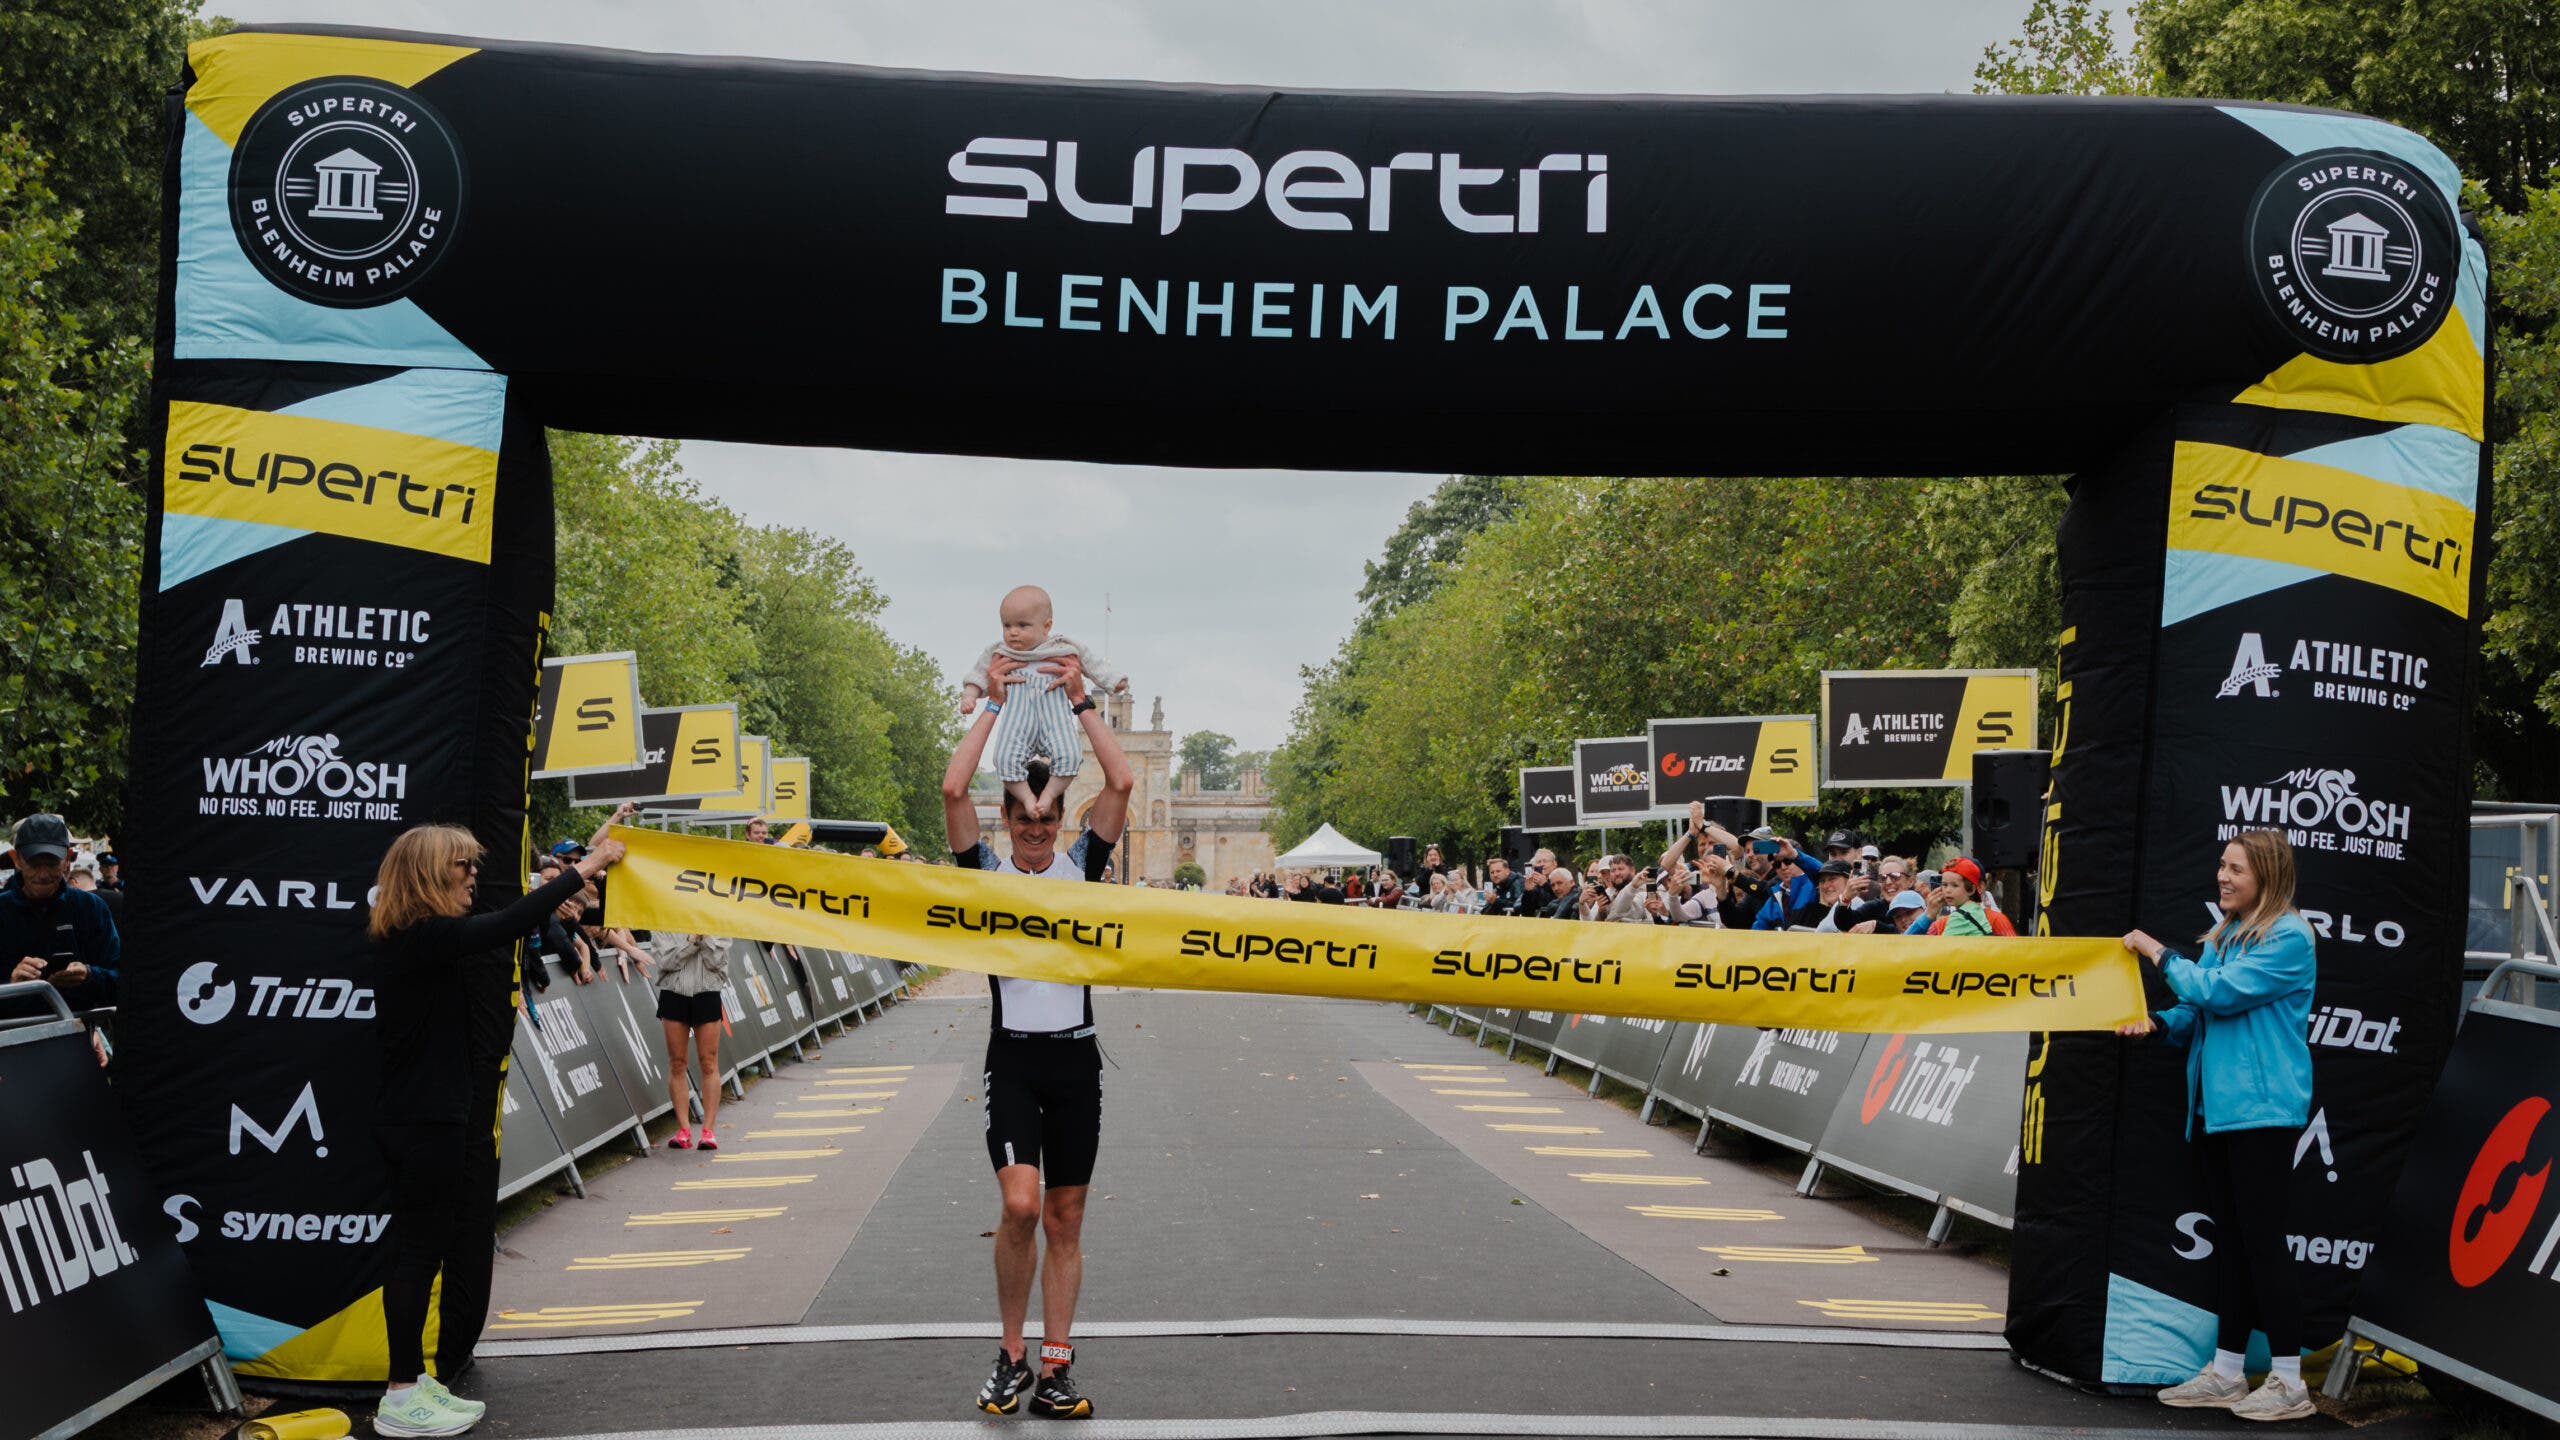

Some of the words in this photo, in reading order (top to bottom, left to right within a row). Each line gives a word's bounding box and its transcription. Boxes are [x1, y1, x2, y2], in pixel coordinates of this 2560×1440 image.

[287, 97, 417, 134] SUPERTRI
[2298, 166, 2417, 201] SUPERTRI
[251, 198, 354, 287] BLENHEIM
[366, 207, 442, 285] PALACE
[941, 269, 1398, 340] BLENHEIM
[1445, 284, 1792, 340] PALACE
[2268, 254, 2359, 344] BLENHEIM
[2370, 271, 2440, 343] PALACE
[270, 603, 431, 644] ATHLETIC
[295, 647, 377, 668] BREWING
[2290, 639, 2428, 689] ATHLETIC
[2313, 681, 2387, 707] BREWING
[1872, 713, 1944, 731] ATHLETIC
[1884, 733, 1922, 743] BREWING
[203, 757, 407, 799] WHOOSH
[1689, 755, 1745, 773] TriDot
[199, 797, 219, 814] NO
[222, 798, 261, 816] FUSS.
[266, 800, 287, 817] NO
[290, 801, 320, 818] FEE.
[324, 802, 361, 820] JUST
[365, 803, 403, 821] RIDE.
[2221, 785, 2410, 840] WHOOSH
[2217, 824, 2238, 841] NO
[2287, 829, 2307, 847] NO
[2310, 831, 2338, 850] FEE.
[2341, 835, 2374, 855] JUST
[2376, 840, 2405, 861] RIDE.
[2205, 901, 2405, 947] VRLO
[2307, 1005, 2401, 1054] iDot
[1889, 1041, 1981, 1127] TriDot
[220, 1210, 392, 1244] synergy
[2286, 1234, 2375, 1270] nerg
